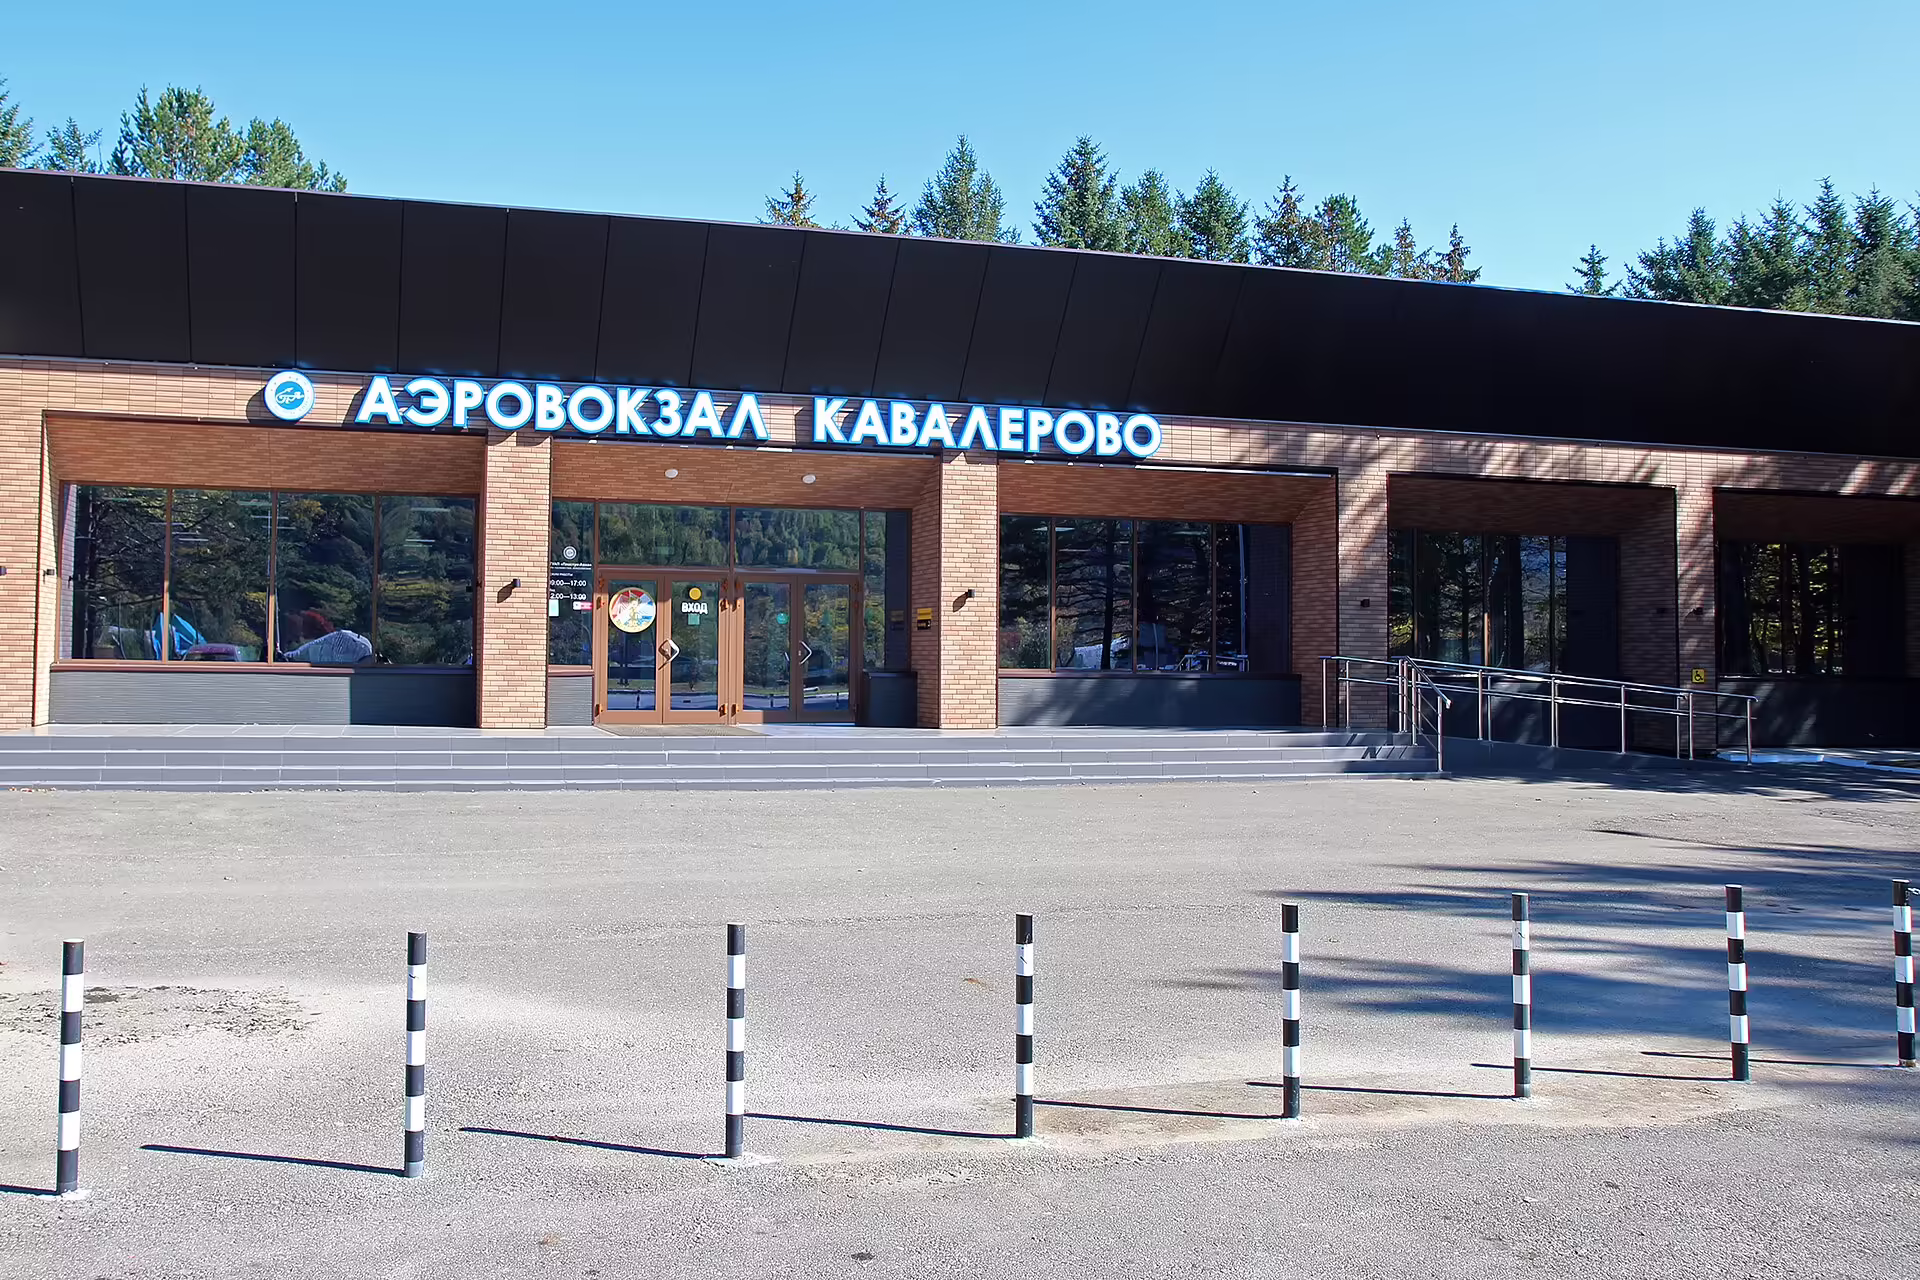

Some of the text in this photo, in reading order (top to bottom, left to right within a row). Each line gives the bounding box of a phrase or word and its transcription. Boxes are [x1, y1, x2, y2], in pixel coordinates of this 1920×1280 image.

[354, 375, 771, 440] АЭРОВОКЗАЛ
[812, 396, 1163, 457] КАВАЛЕРОВО
[681, 602, 708, 615] ВХОД
